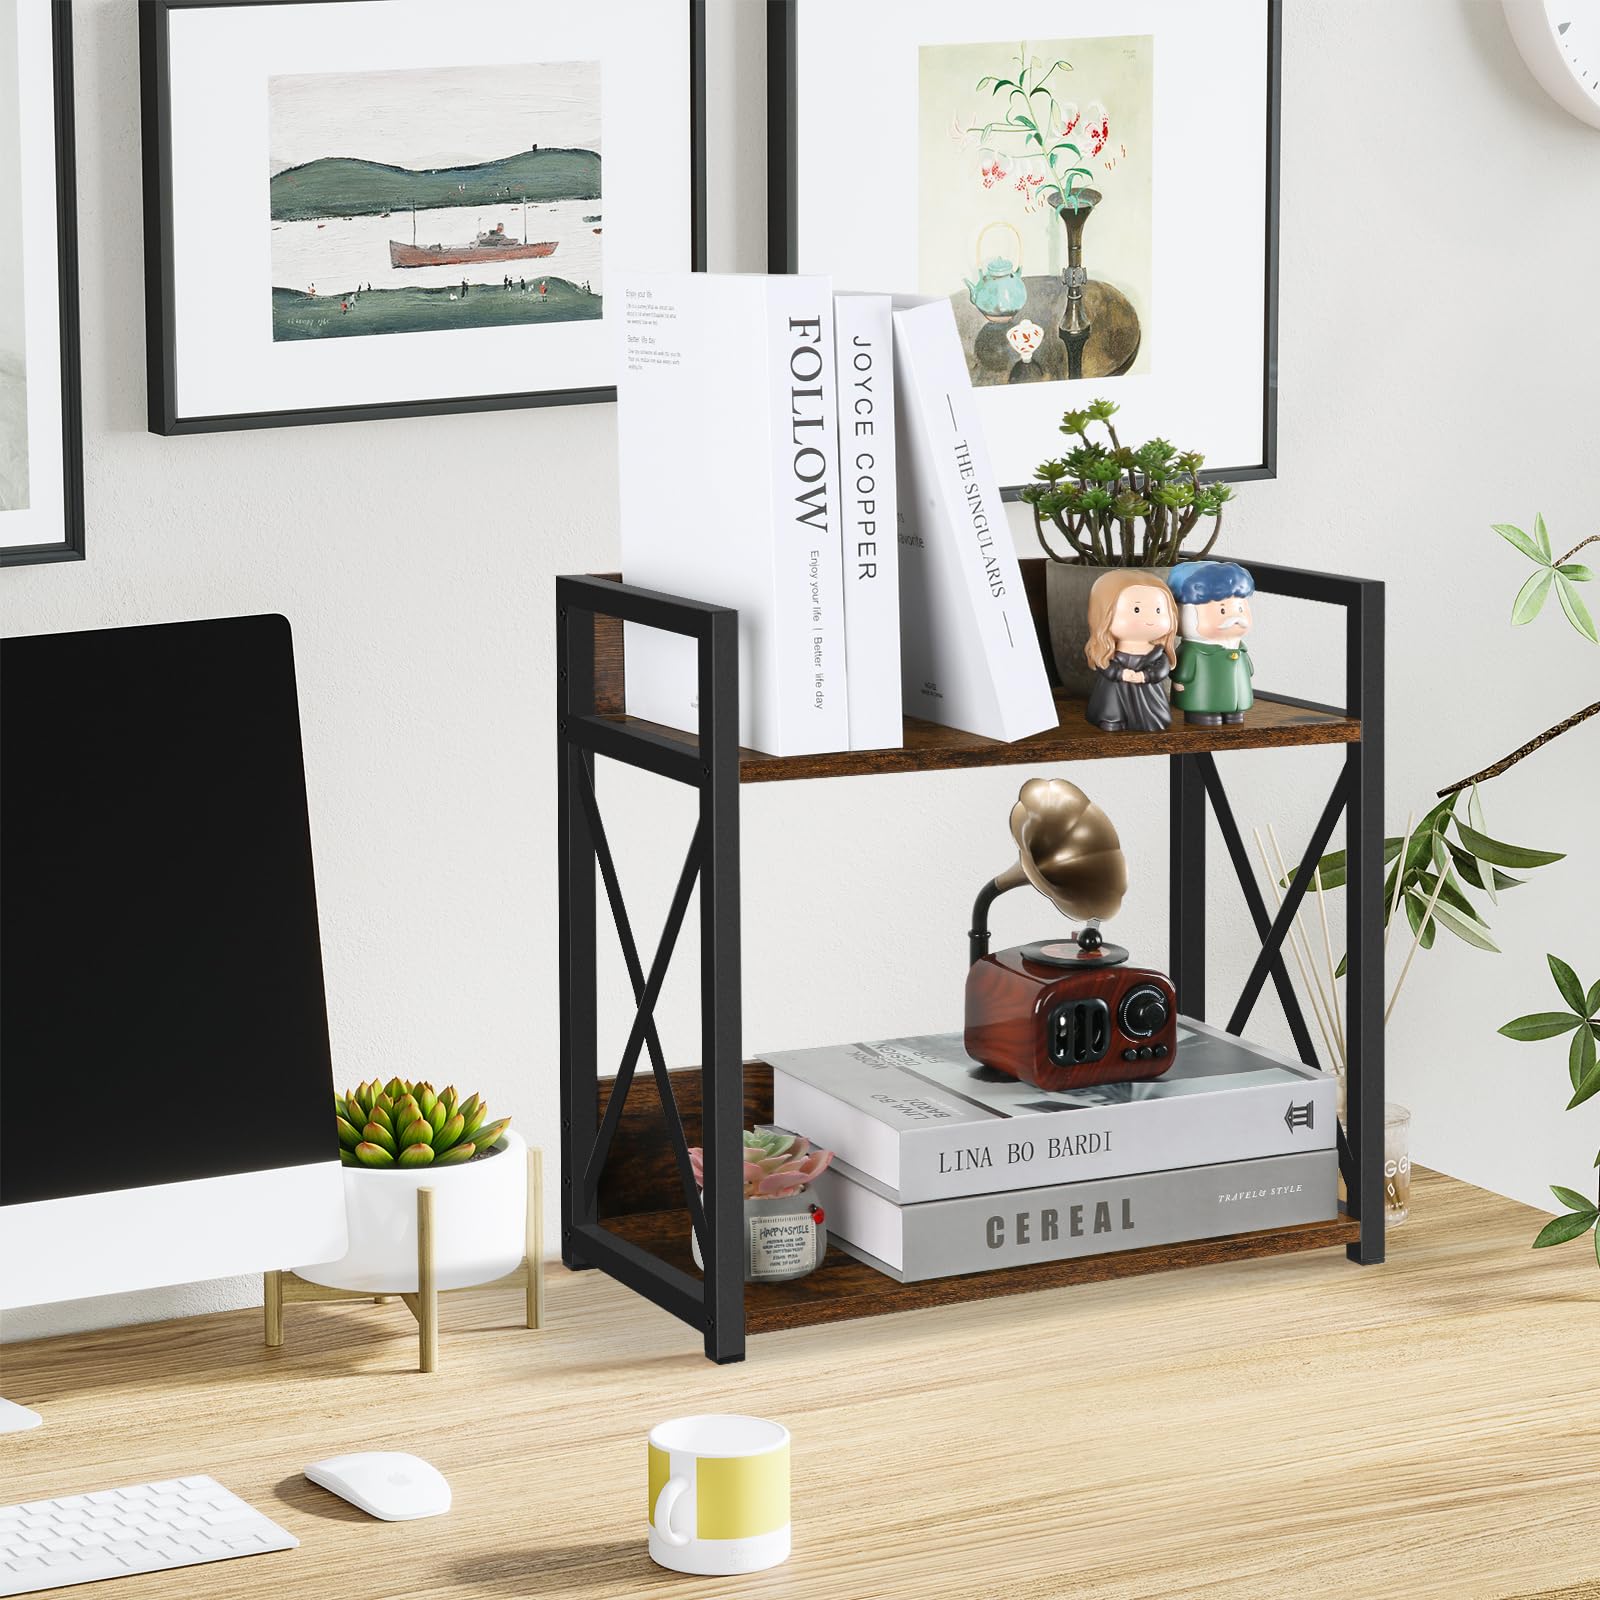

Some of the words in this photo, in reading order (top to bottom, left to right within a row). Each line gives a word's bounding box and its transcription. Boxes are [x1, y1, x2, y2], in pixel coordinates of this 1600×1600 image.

[852, 335, 874, 437] JOYCE
[788, 314, 829, 534] FOLLOW
[954, 439, 975, 480] THE
[855, 453, 877, 581] COPPER
[964, 482, 1006, 599] SINGULARIS
[809, 550, 820, 579] Enjoy
[809, 581, 819, 604] your
[812, 607, 822, 622] life
[813, 636, 823, 667] Better
[815, 673, 825, 688] life
[814, 690, 825, 710] day
[870, 1094, 898, 1103] BO
[890, 1103, 929, 1120] LINA
[902, 1098, 951, 1118] BARDI
[939, 1146, 993, 1174] LINA
[1007, 1141, 1035, 1165] BO
[1047, 1131, 1113, 1159] BARDI
[1270, 1184, 1303, 1196] STYLE
[985, 1198, 1136, 1250] CEREAL
